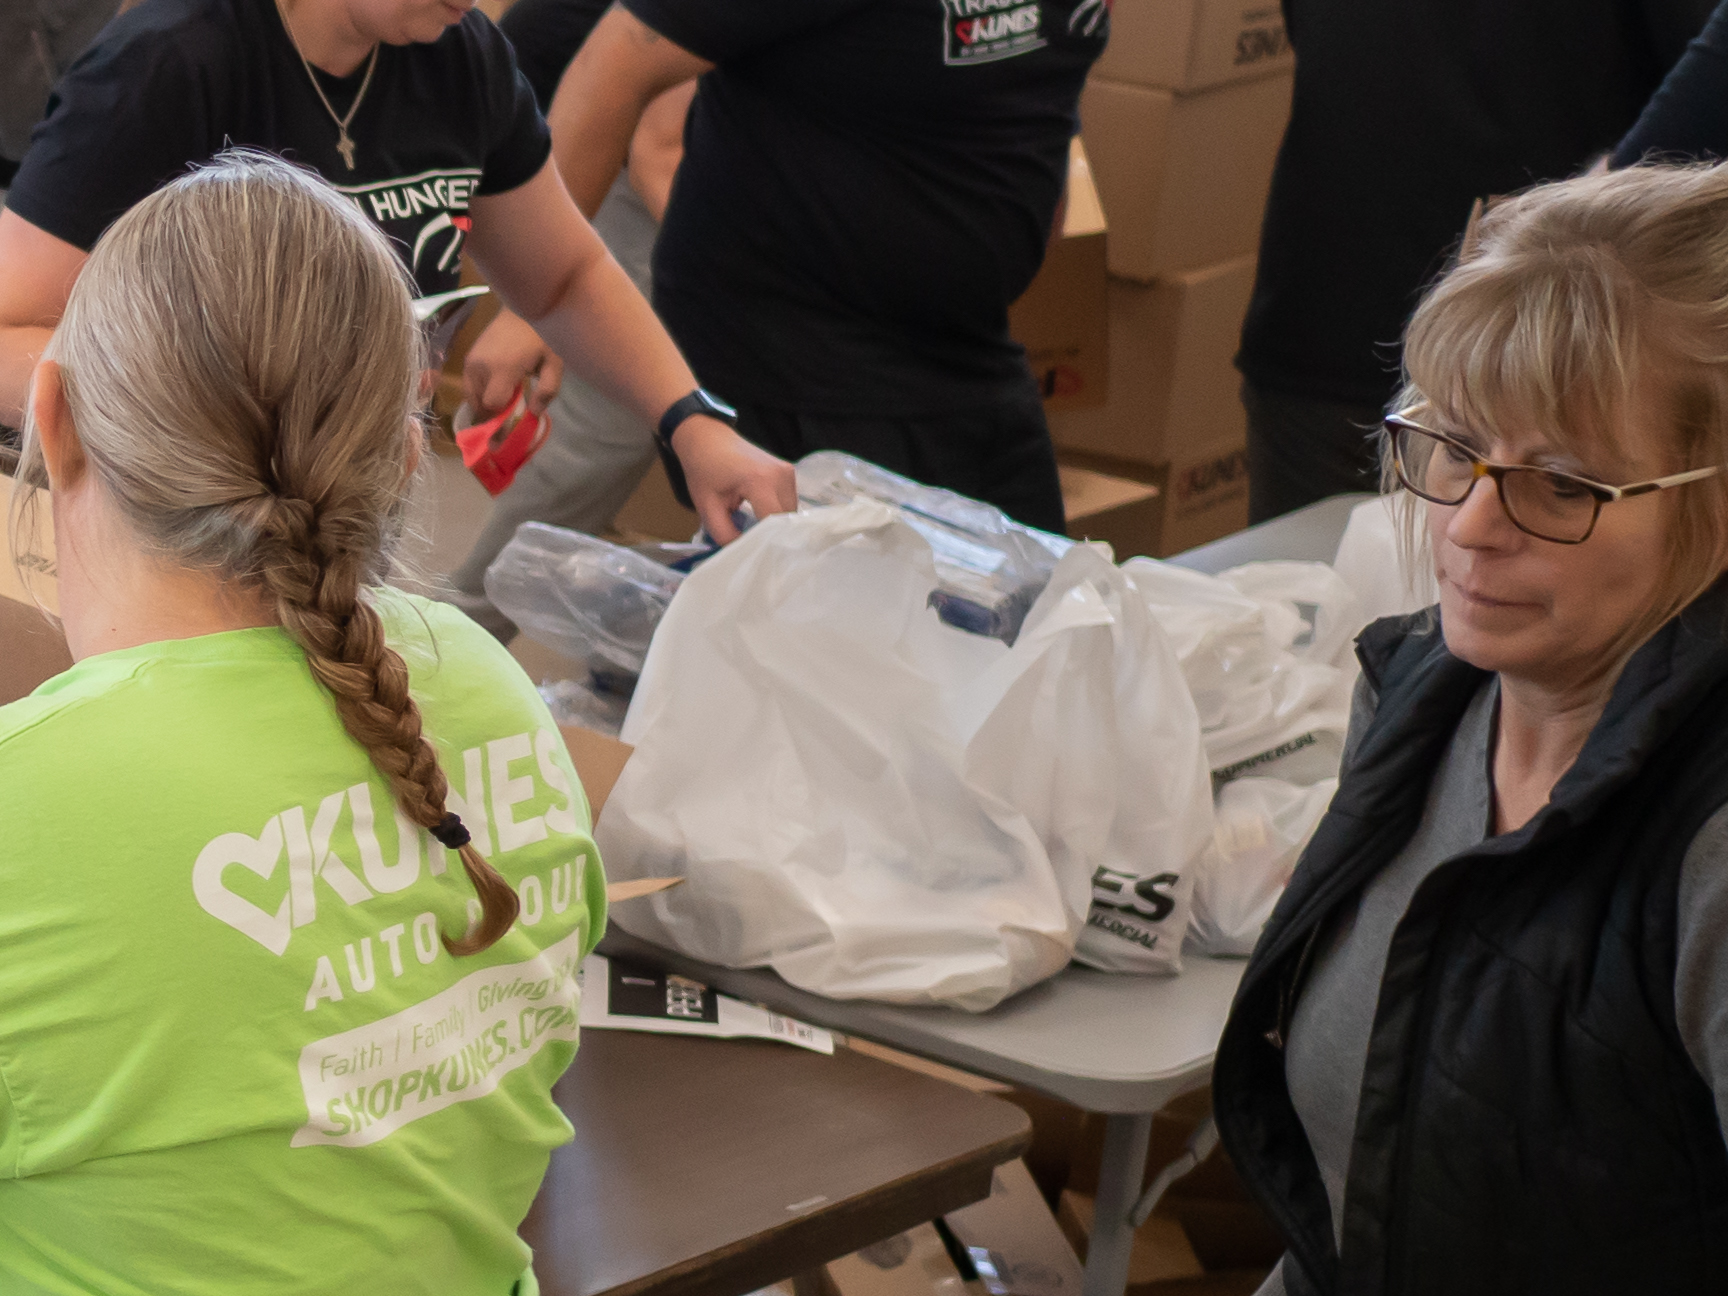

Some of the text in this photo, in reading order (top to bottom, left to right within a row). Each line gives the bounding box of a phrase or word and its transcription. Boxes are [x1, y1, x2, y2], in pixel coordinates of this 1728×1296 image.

[304, 911, 439, 1012] AUTO
[318, 972, 549, 1082] Faith Family Giving
